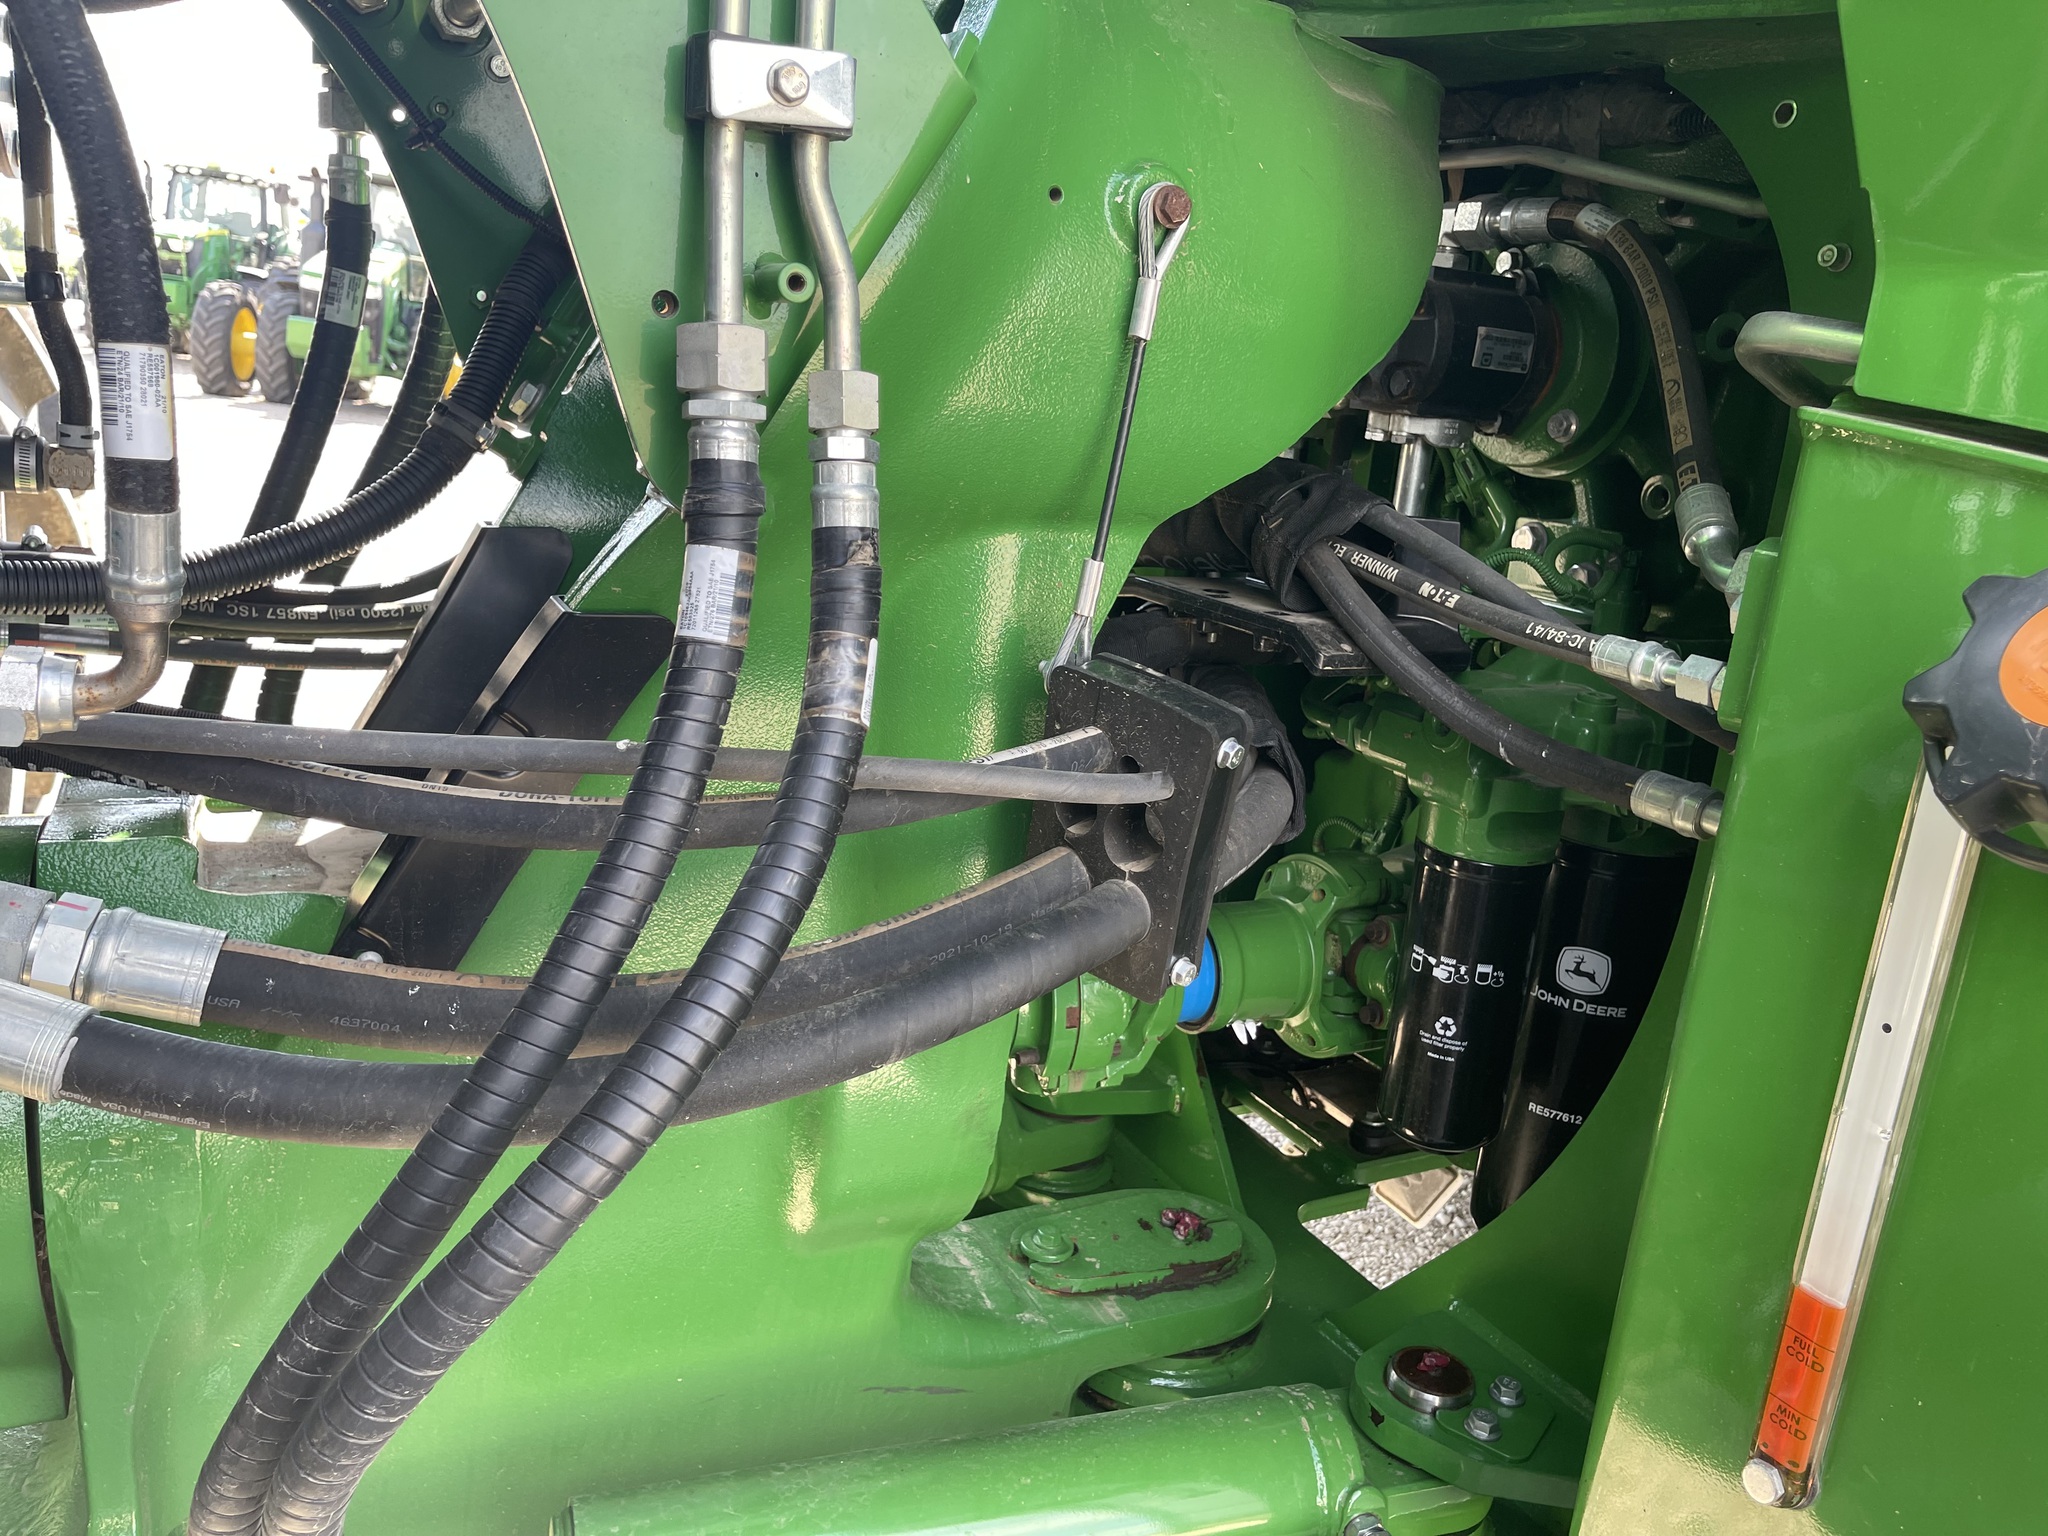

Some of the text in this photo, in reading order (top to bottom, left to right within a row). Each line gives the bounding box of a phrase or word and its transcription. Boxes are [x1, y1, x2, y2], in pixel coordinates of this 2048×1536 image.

[1623, 243, 1642, 263] BAR
[124, 350, 132, 391] QUALIFIED
[124, 392, 132, 403] TO
[1350, 551, 1399, 582] WINNER
[226, 603, 259, 618] 1SC
[1526, 622, 1587, 650] IC-84/41
[929, 923, 1014, 966] 2021-10-19
[206, 995, 241, 1010] USA
[1530, 985, 1628, 1018] JOHN DEERE
[1442, 1038, 1462, 1047] dispose
[1444, 1044, 1466, 1052] properly
[100, 1100, 128, 1114] USA
[130, 1106, 142, 1115] in
[1528, 1101, 1583, 1125] RE577612
[1786, 1344, 1826, 1373] COLD
[1792, 1335, 1820, 1360] FULL
[1769, 1412, 1808, 1441] COLD
[1776, 1404, 1802, 1426] MIN
